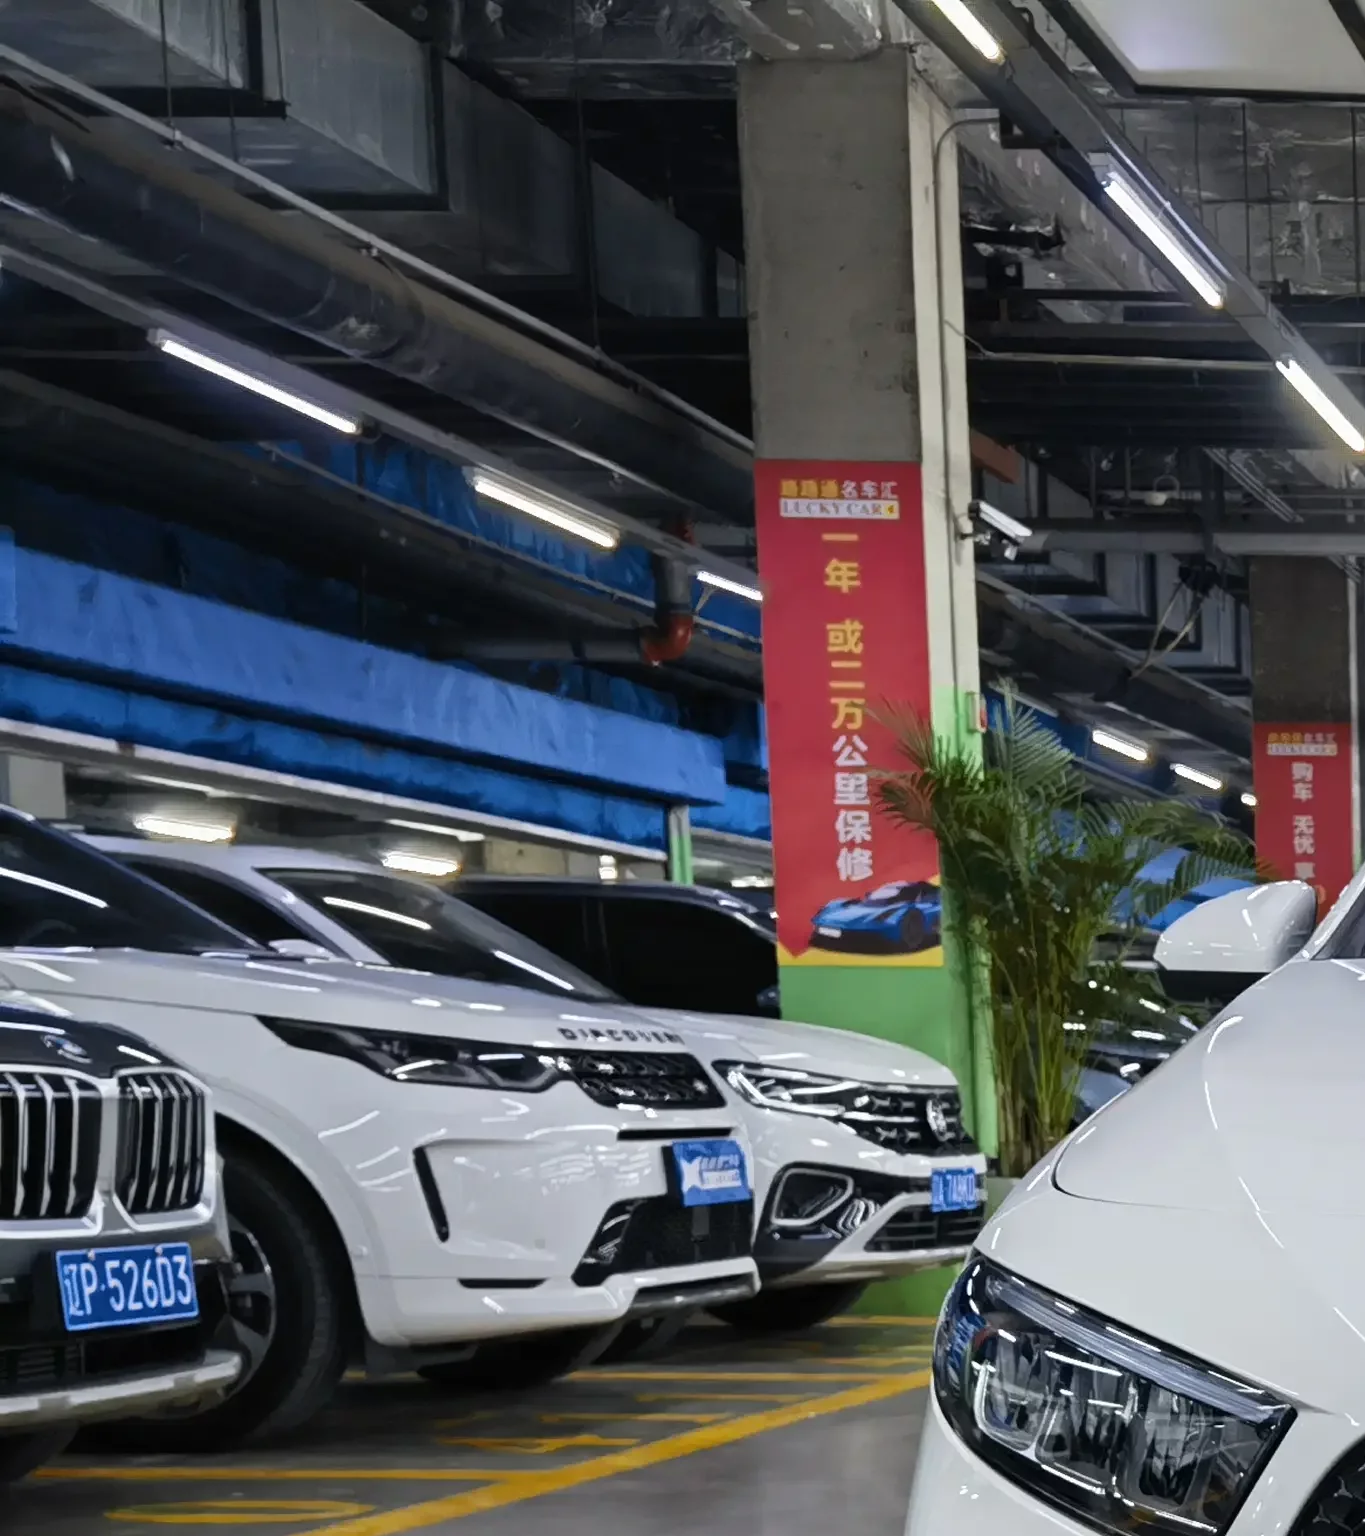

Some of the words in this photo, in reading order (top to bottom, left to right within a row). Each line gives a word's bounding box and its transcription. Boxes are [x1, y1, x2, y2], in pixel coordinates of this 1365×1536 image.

[822, 533, 861, 592] 一年
[826, 619, 873, 881] 或二万公里保修
